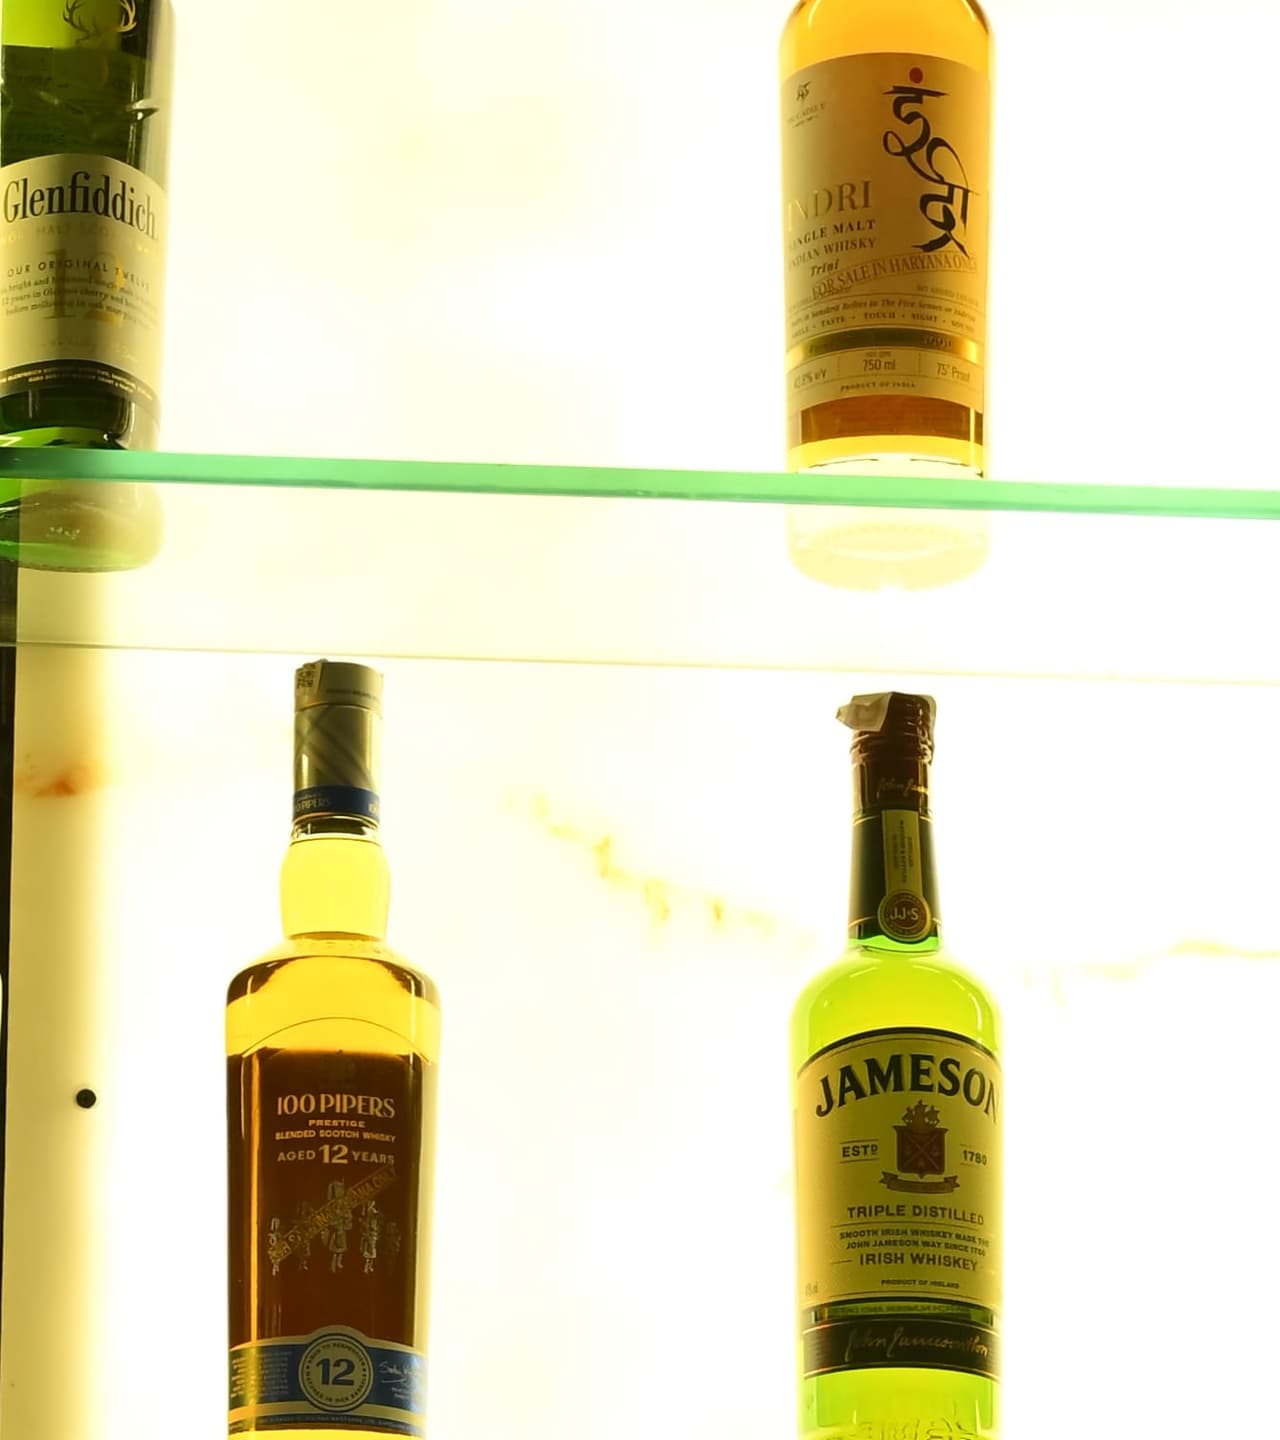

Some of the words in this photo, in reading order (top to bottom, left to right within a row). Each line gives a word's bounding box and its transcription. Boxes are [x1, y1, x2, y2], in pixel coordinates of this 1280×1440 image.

[3, 170, 158, 241] Glenfiddich
[832, 218, 877, 235] MALT
[823, 237, 877, 256] WHISKY
[890, 254, 955, 273] HARYANA
[815, 1053, 999, 1124] JAMESON
[276, 1094, 316, 1117] 100
[319, 1092, 397, 1119] PIPERS
[308, 1118, 366, 1128] PRESTIGE
[274, 1130, 317, 1142] BLENDED
[318, 1130, 360, 1140] SCOTCH
[362, 1133, 397, 1144] WHISKY
[276, 1149, 317, 1164] AGED
[318, 1143, 349, 1165] 12
[351, 1149, 396, 1165] YEARS
[846, 1203, 906, 1219] TRIPLE
[910, 1205, 985, 1226] DISTILLED
[839, 1228, 879, 1241] SMOOTH
[910, 1228, 953, 1239] WHISKEY
[871, 1238, 919, 1248] JAMESON
[859, 1252, 905, 1267] IRISH
[909, 1252, 979, 1272] WHISKEY
[314, 1357, 356, 1387] 12
